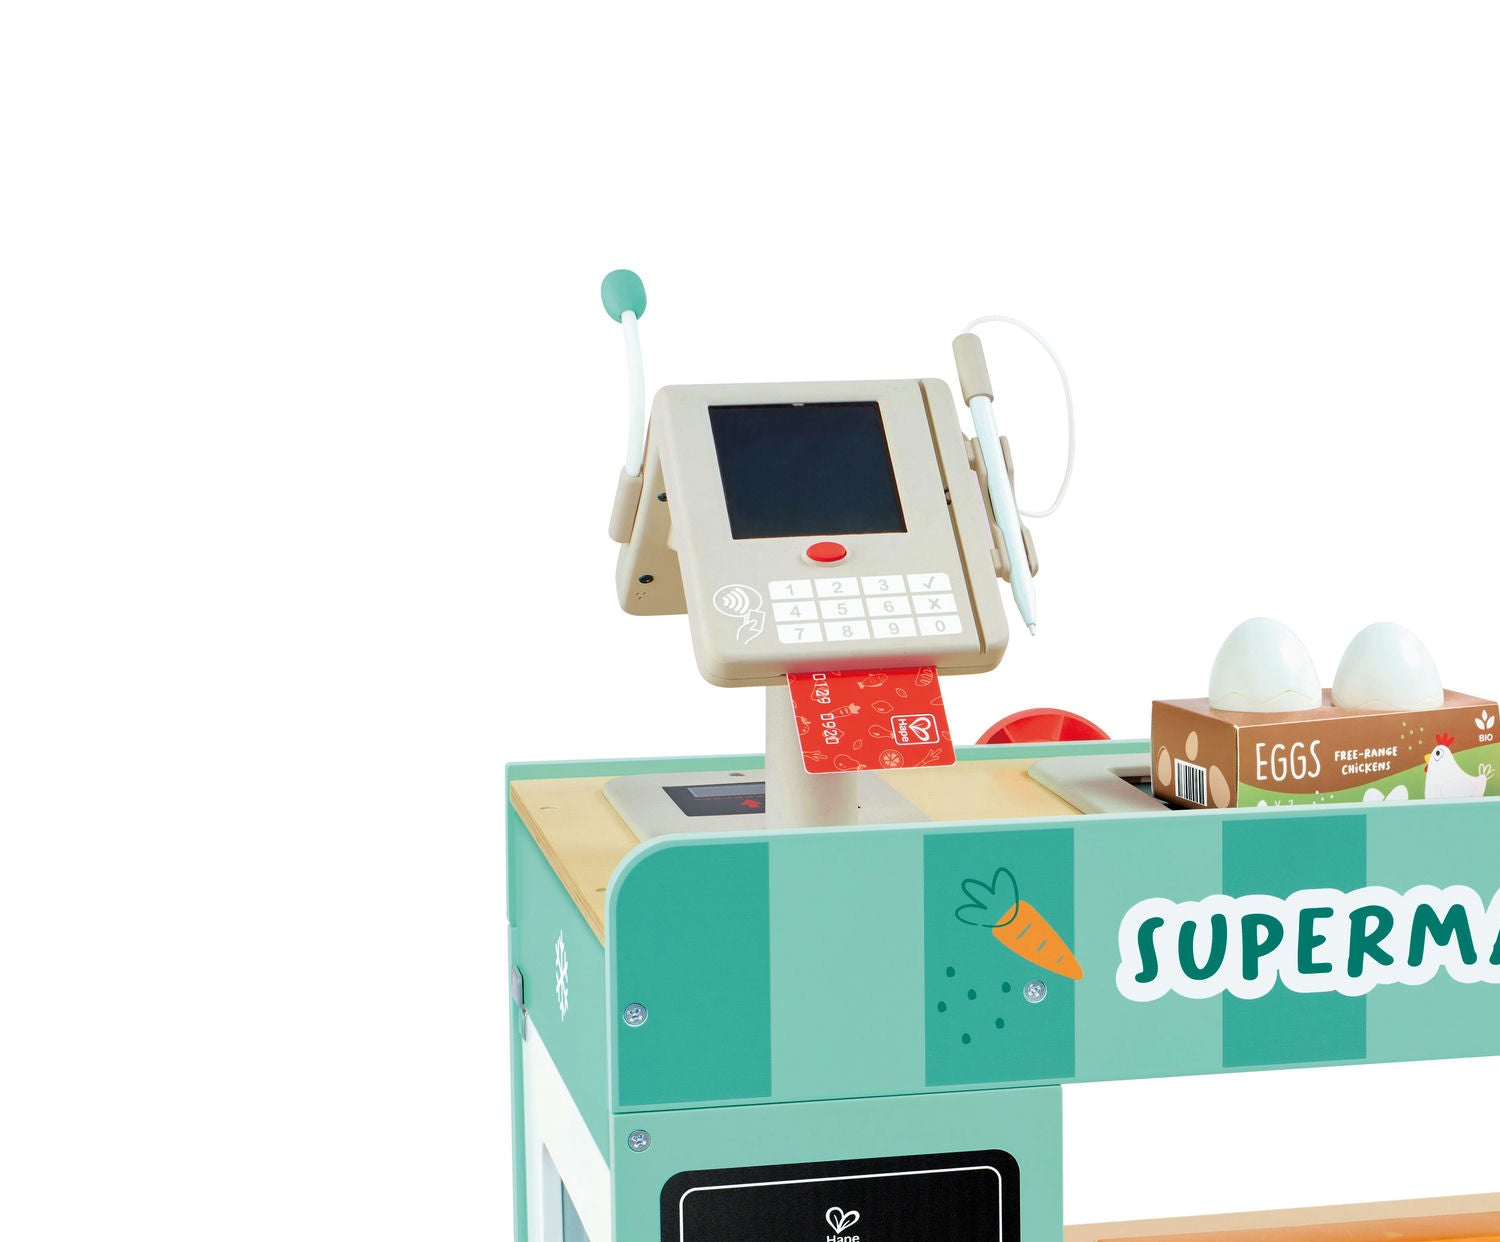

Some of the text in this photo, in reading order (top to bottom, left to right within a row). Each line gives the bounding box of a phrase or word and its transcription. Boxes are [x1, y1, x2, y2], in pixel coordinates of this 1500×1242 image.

[785, 579, 889, 596] 1 2 3
[790, 605, 801, 617] 4
[837, 603, 848, 615] 5
[883, 600, 895, 612] 6
[794, 620, 946, 640] 7 8 9 0
[896, 718, 909, 743] Hape
[1478, 733, 1494, 743] BIO
[1255, 740, 1321, 782] EGGS
[1334, 746, 1398, 762] FREE-RANGE
